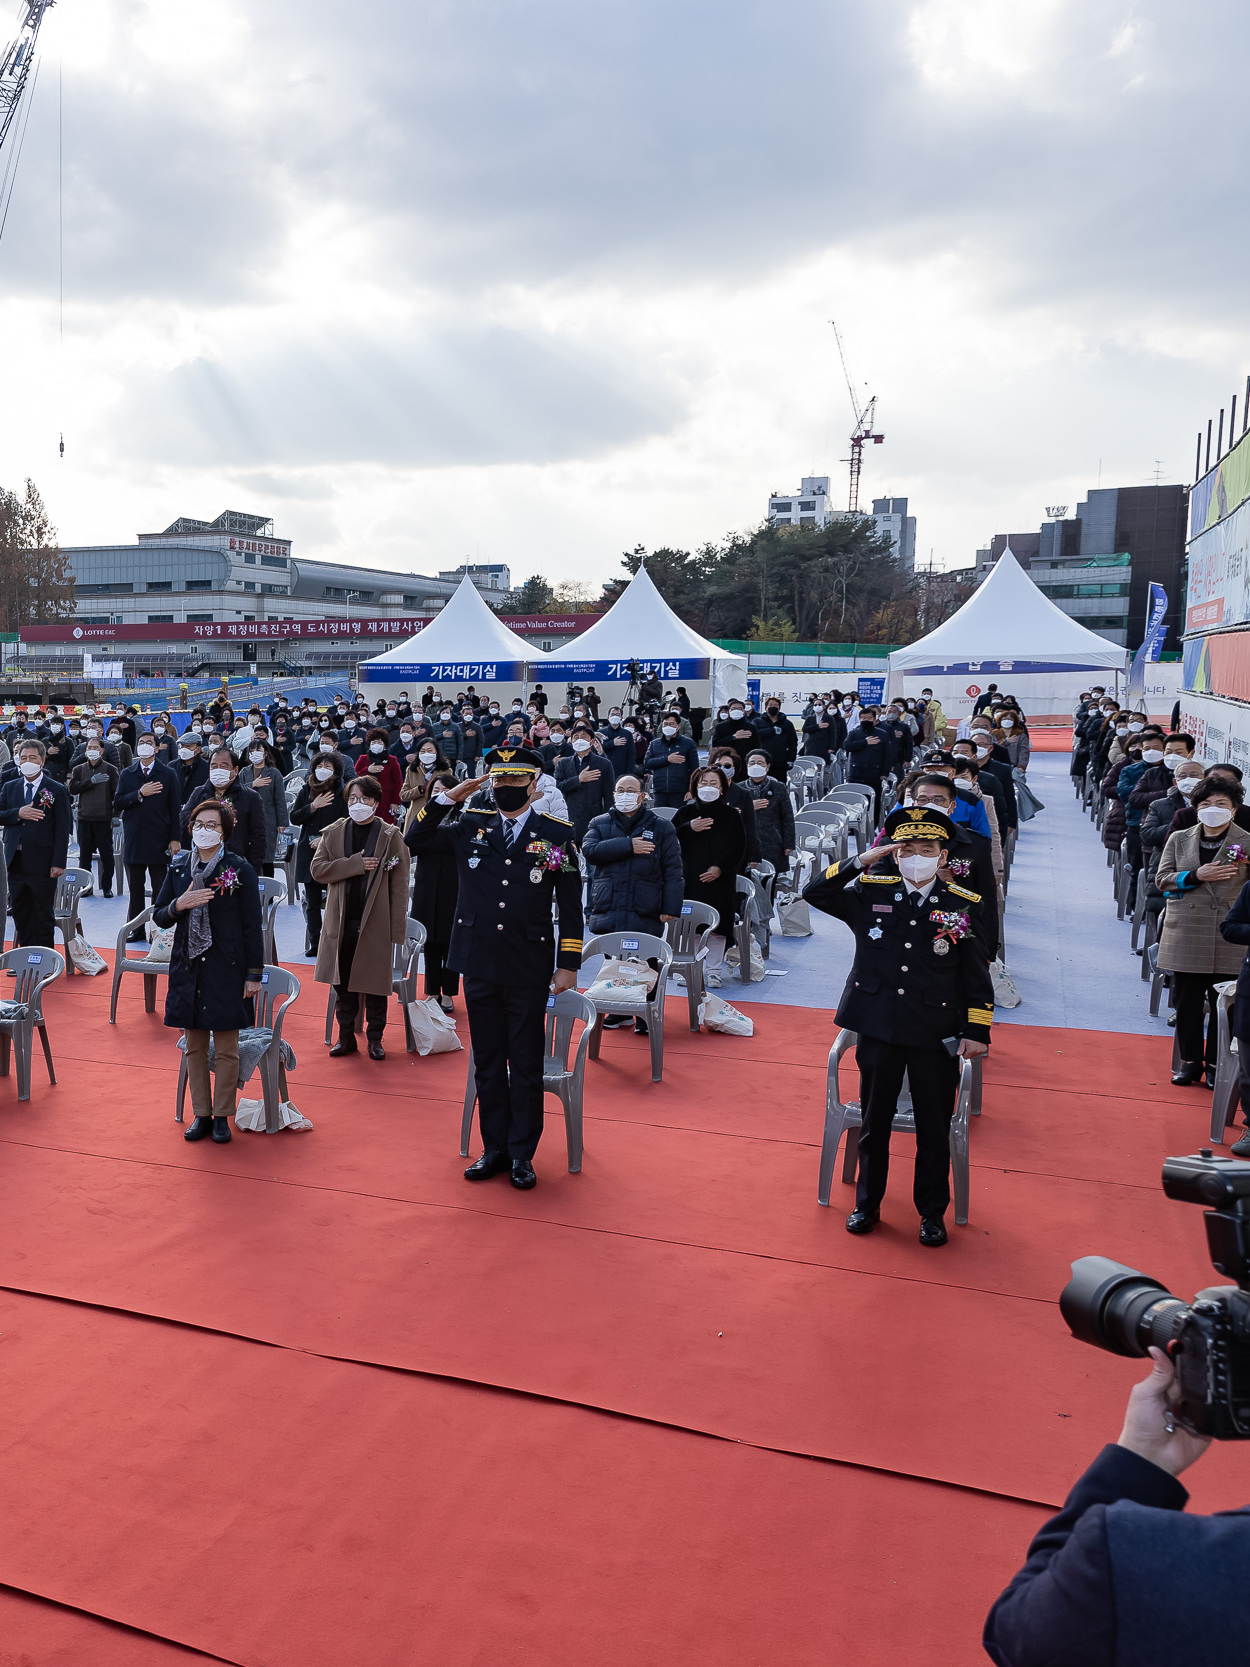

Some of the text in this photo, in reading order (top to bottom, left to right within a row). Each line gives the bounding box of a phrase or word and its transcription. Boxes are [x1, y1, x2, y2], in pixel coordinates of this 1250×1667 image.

[194, 621, 424, 636] 자양1 재정비촉진구역 도시정비형 재개발사업
[548, 620, 576, 628] Creator
[430, 664, 497, 679] 기자대기실
